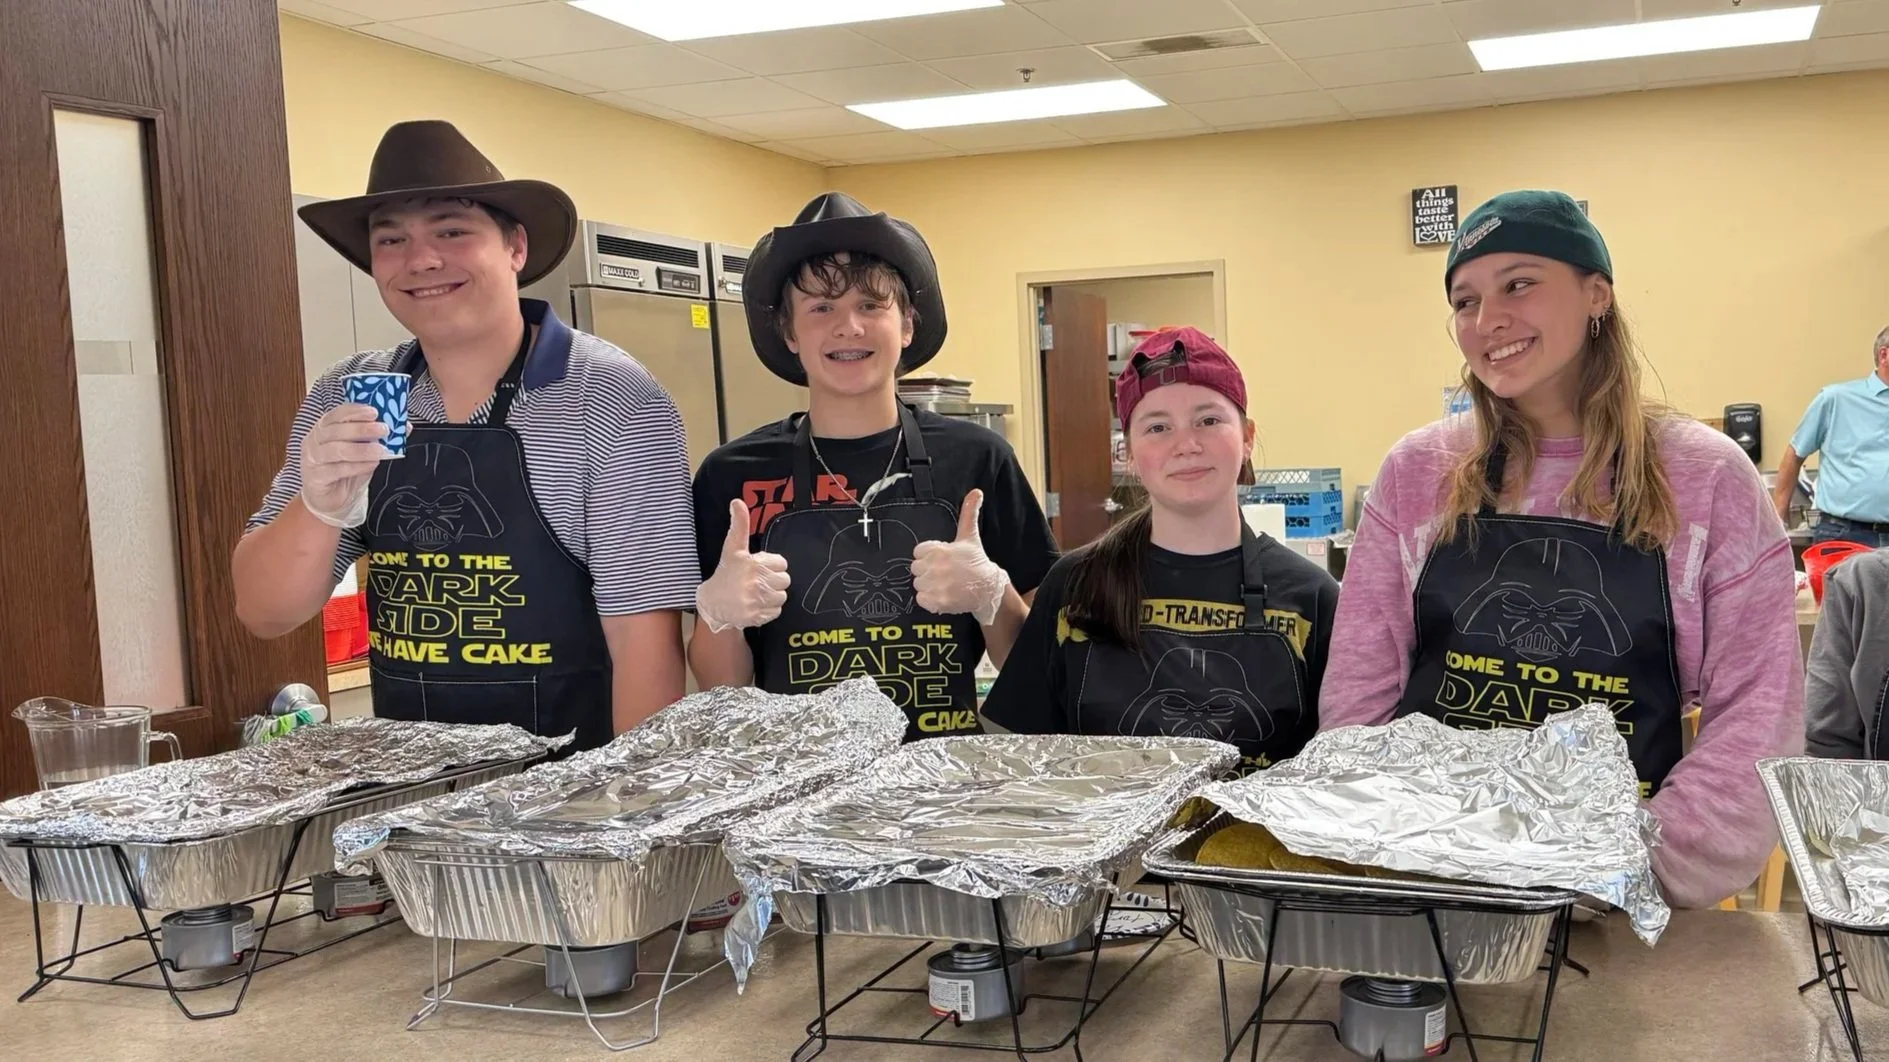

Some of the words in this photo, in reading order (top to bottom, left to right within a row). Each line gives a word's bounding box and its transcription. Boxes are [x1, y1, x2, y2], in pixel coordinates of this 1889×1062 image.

[1415, 197, 1454, 208] things
[1421, 188, 1446, 199] All
[1415, 214, 1455, 224] better
[1418, 206, 1449, 216] taste
[1421, 221, 1454, 231] with
[416, 553, 449, 568] TO
[459, 554, 512, 570] THE
[368, 567, 525, 606] DARK
[377, 600, 506, 639] SIDE
[789, 628, 855, 648] COME
[865, 626, 902, 641] TO
[912, 624, 953, 639] THE
[383, 635, 450, 664] HAVE
[461, 642, 553, 664] CAKE
[788, 643, 962, 684] DARK
[1517, 663, 1559, 684] TO
[1573, 671, 1629, 694] THE
[918, 711, 977, 732] CAKE
